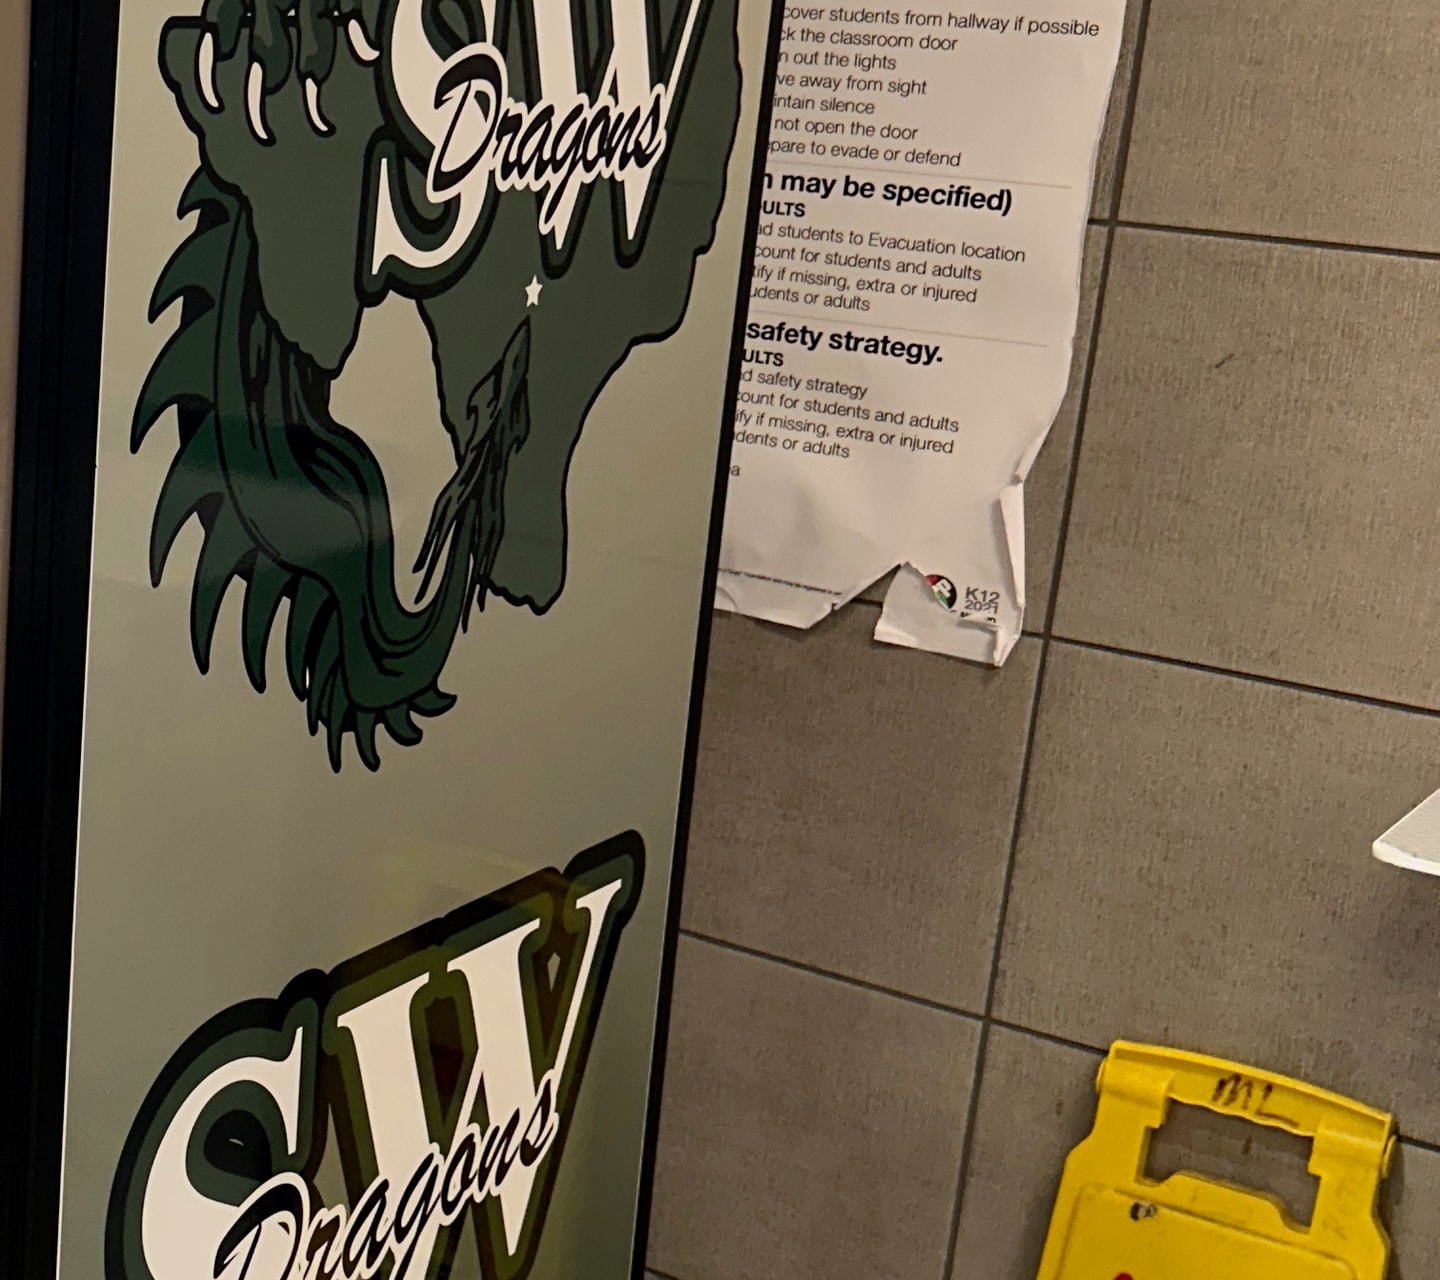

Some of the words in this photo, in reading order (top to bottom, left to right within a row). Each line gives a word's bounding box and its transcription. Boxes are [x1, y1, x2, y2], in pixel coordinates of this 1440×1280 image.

[829, 7, 900, 25] students
[905, 10, 942, 26] from
[947, 12, 1010, 35] hallway
[1014, 16, 1025, 31] if
[1027, 17, 1100, 37] possible
[800, 27, 825, 43] the
[829, 30, 913, 48] classroom
[919, 34, 959, 51] door
[793, 51, 819, 65] out
[824, 51, 849, 67] the
[854, 53, 897, 73] lights
[799, 76, 842, 92] away
[846, 75, 883, 92] from
[888, 80, 928, 98] sight
[819, 97, 875, 115] silence
[433, 52, 666, 227] Dragons
[774, 118, 799, 131] not
[804, 120, 844, 136] open
[850, 121, 875, 137] the
[880, 124, 919, 140] door
[810, 141, 826, 156] to
[831, 143, 879, 160] evade
[883, 148, 901, 161] or
[905, 147, 962, 167] defend
[780, 173, 836, 199] may
[842, 175, 875, 198] be
[882, 180, 1012, 217] specified)
[777, 225, 844, 244] students
[849, 230, 864, 245] to
[868, 232, 956, 256] Evacuation
[961, 236, 1026, 263] location
[800, 247, 820, 263] for
[824, 250, 891, 272] students
[896, 256, 927, 274] and
[932, 260, 982, 280] adults
[777, 267, 786, 281] if
[789, 269, 850, 292] missing,
[856, 276, 895, 295] extra
[900, 281, 918, 295] or
[922, 281, 977, 303] injured
[804, 292, 819, 305] or
[824, 293, 870, 312] adults
[747, 321, 823, 350] safety
[828, 331, 943, 366] strategy.
[757, 371, 802, 391] safety
[806, 377, 868, 400] strategy
